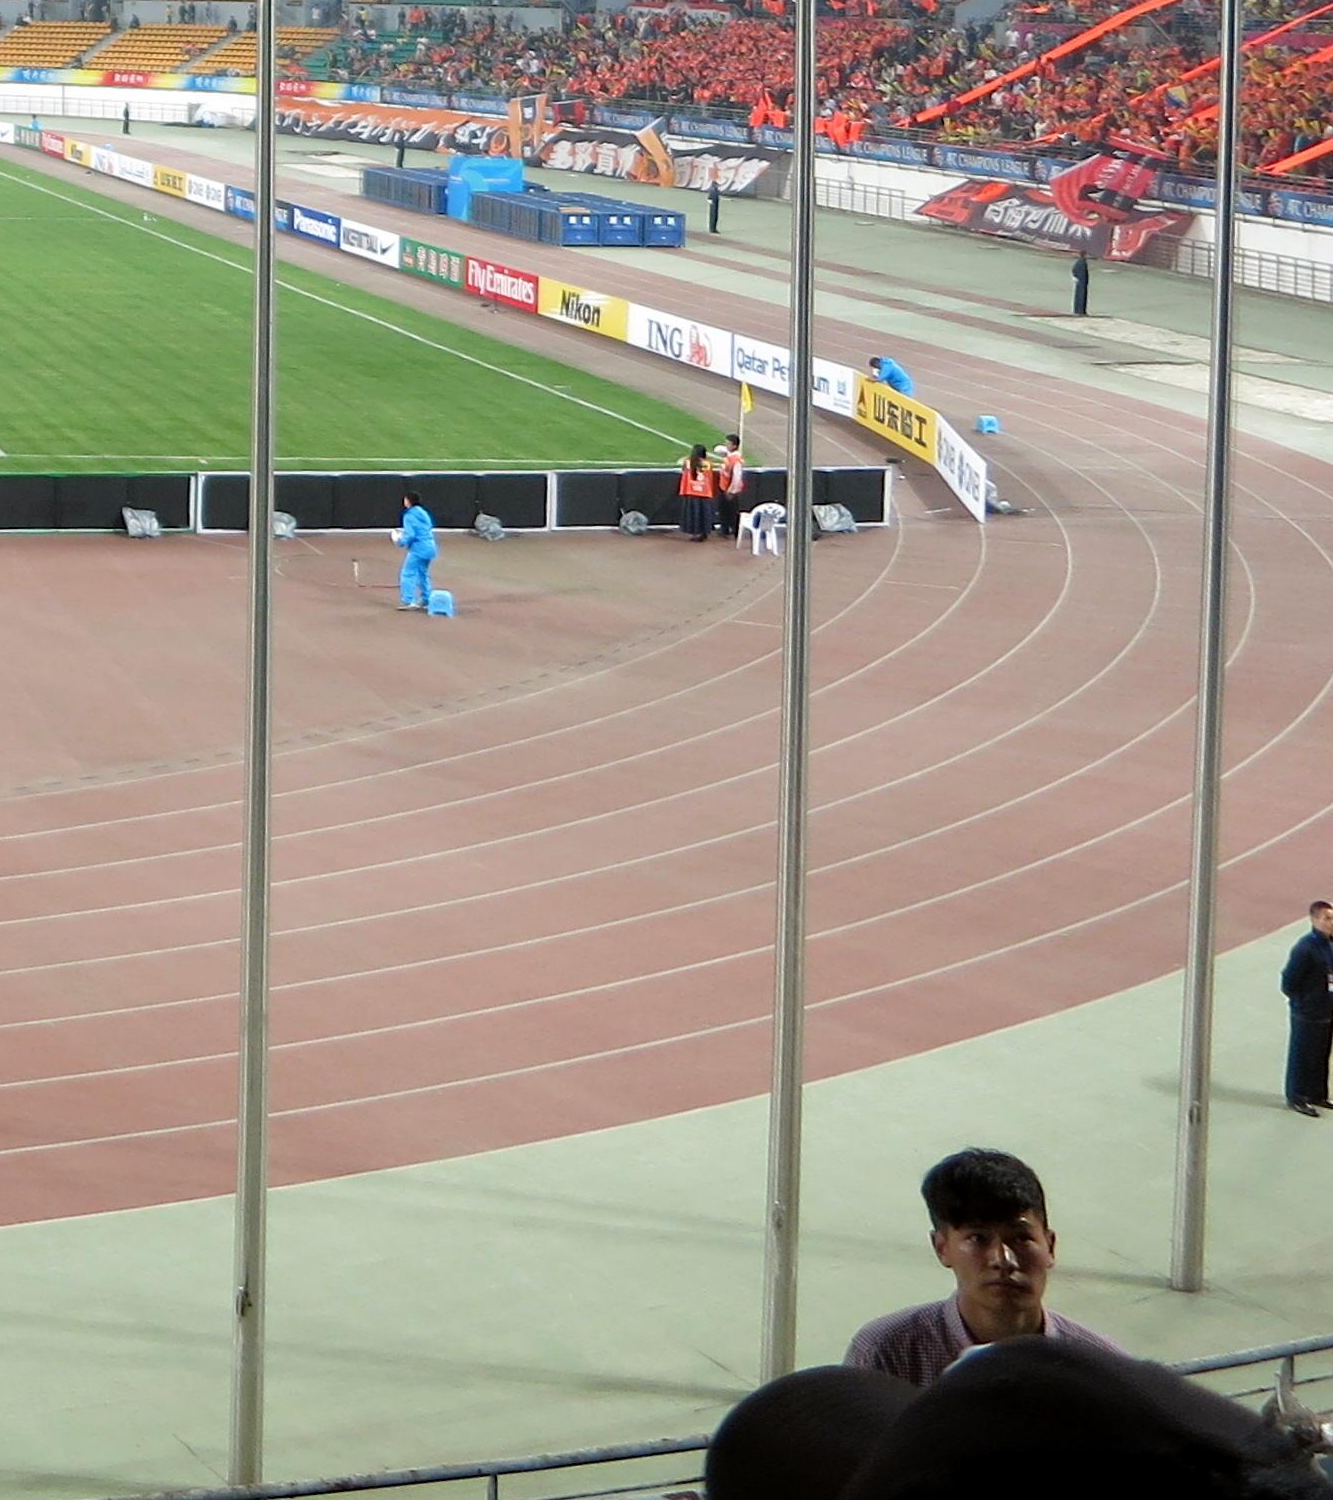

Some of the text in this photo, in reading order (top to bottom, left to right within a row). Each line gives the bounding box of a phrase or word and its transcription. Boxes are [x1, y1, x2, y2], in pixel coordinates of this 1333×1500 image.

[293, 208, 337, 243] Panasonic
[468, 259, 534, 304] Fly Emirates
[560, 290, 601, 327] Nikon
[647, 318, 684, 358] ING
[736, 347, 769, 376] Qatar
[873, 392, 928, 449] 山东临工
